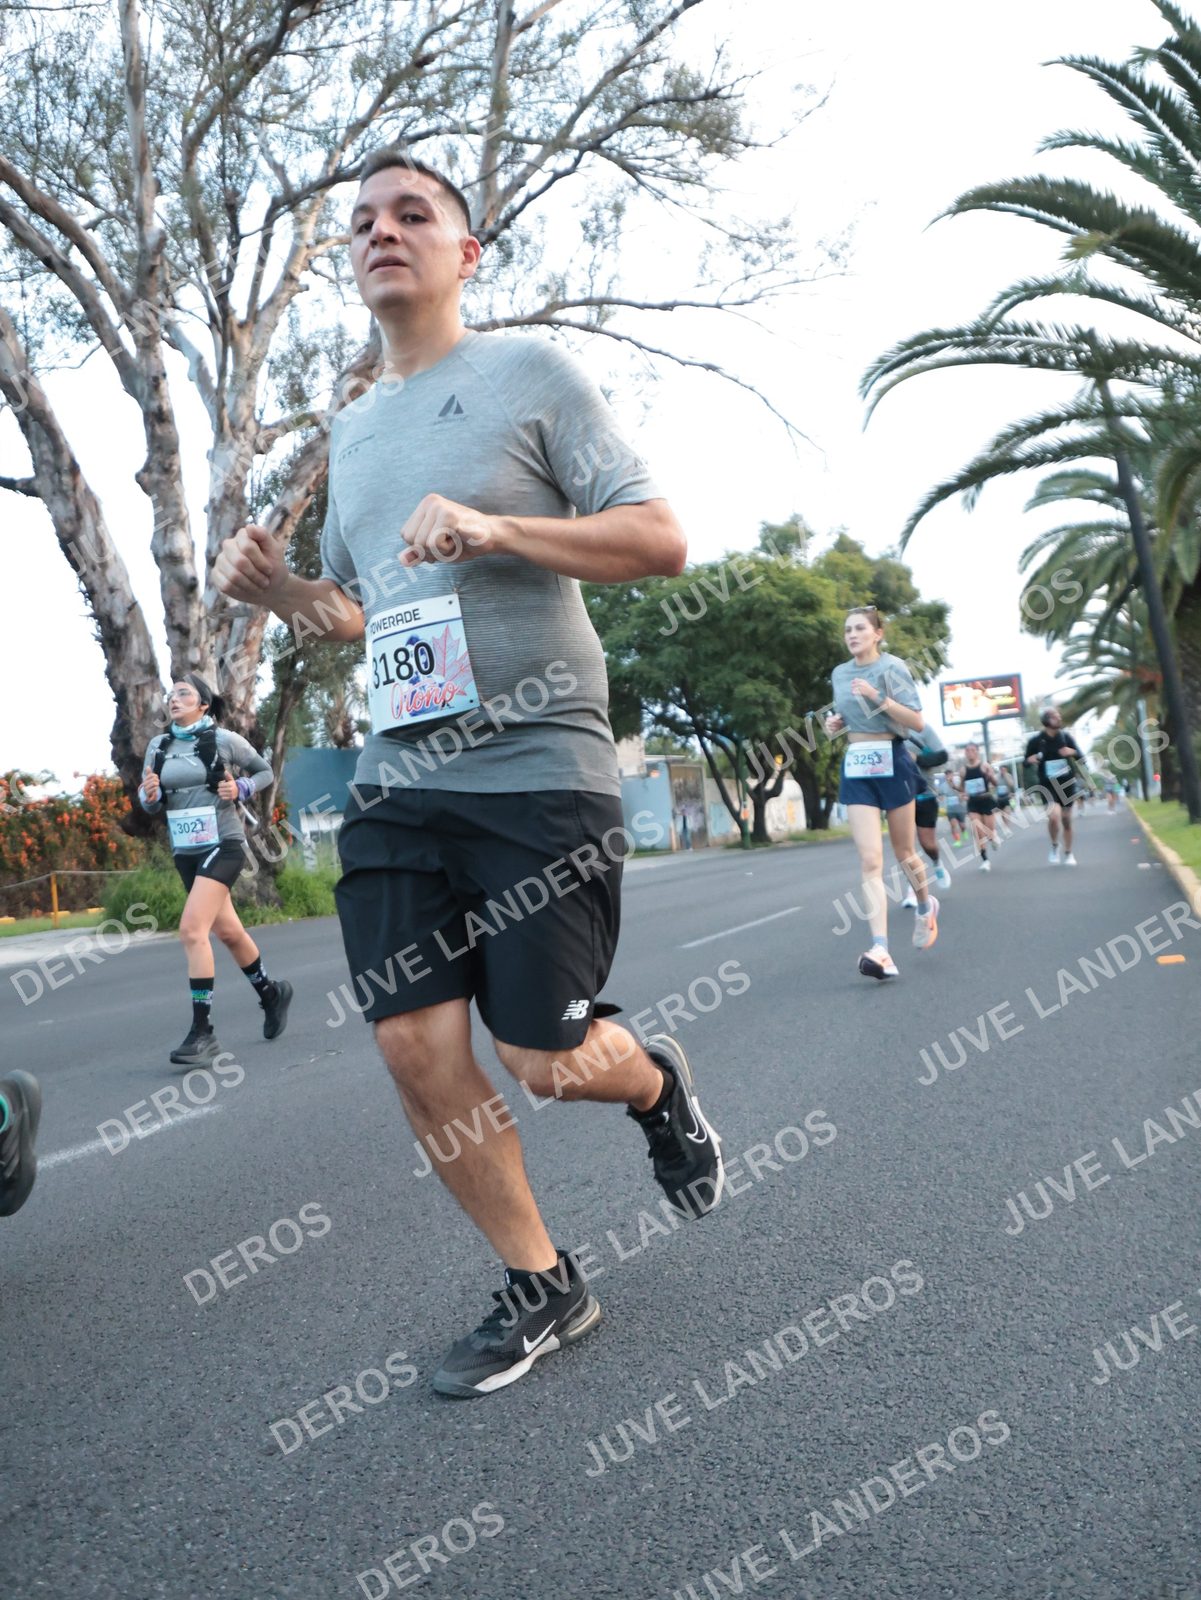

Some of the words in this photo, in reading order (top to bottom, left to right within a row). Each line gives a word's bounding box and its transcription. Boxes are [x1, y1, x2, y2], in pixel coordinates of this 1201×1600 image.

[373, 641, 435, 689] 3180
[853, 753, 882, 765] 3253
[177, 820, 205, 834] 3021
